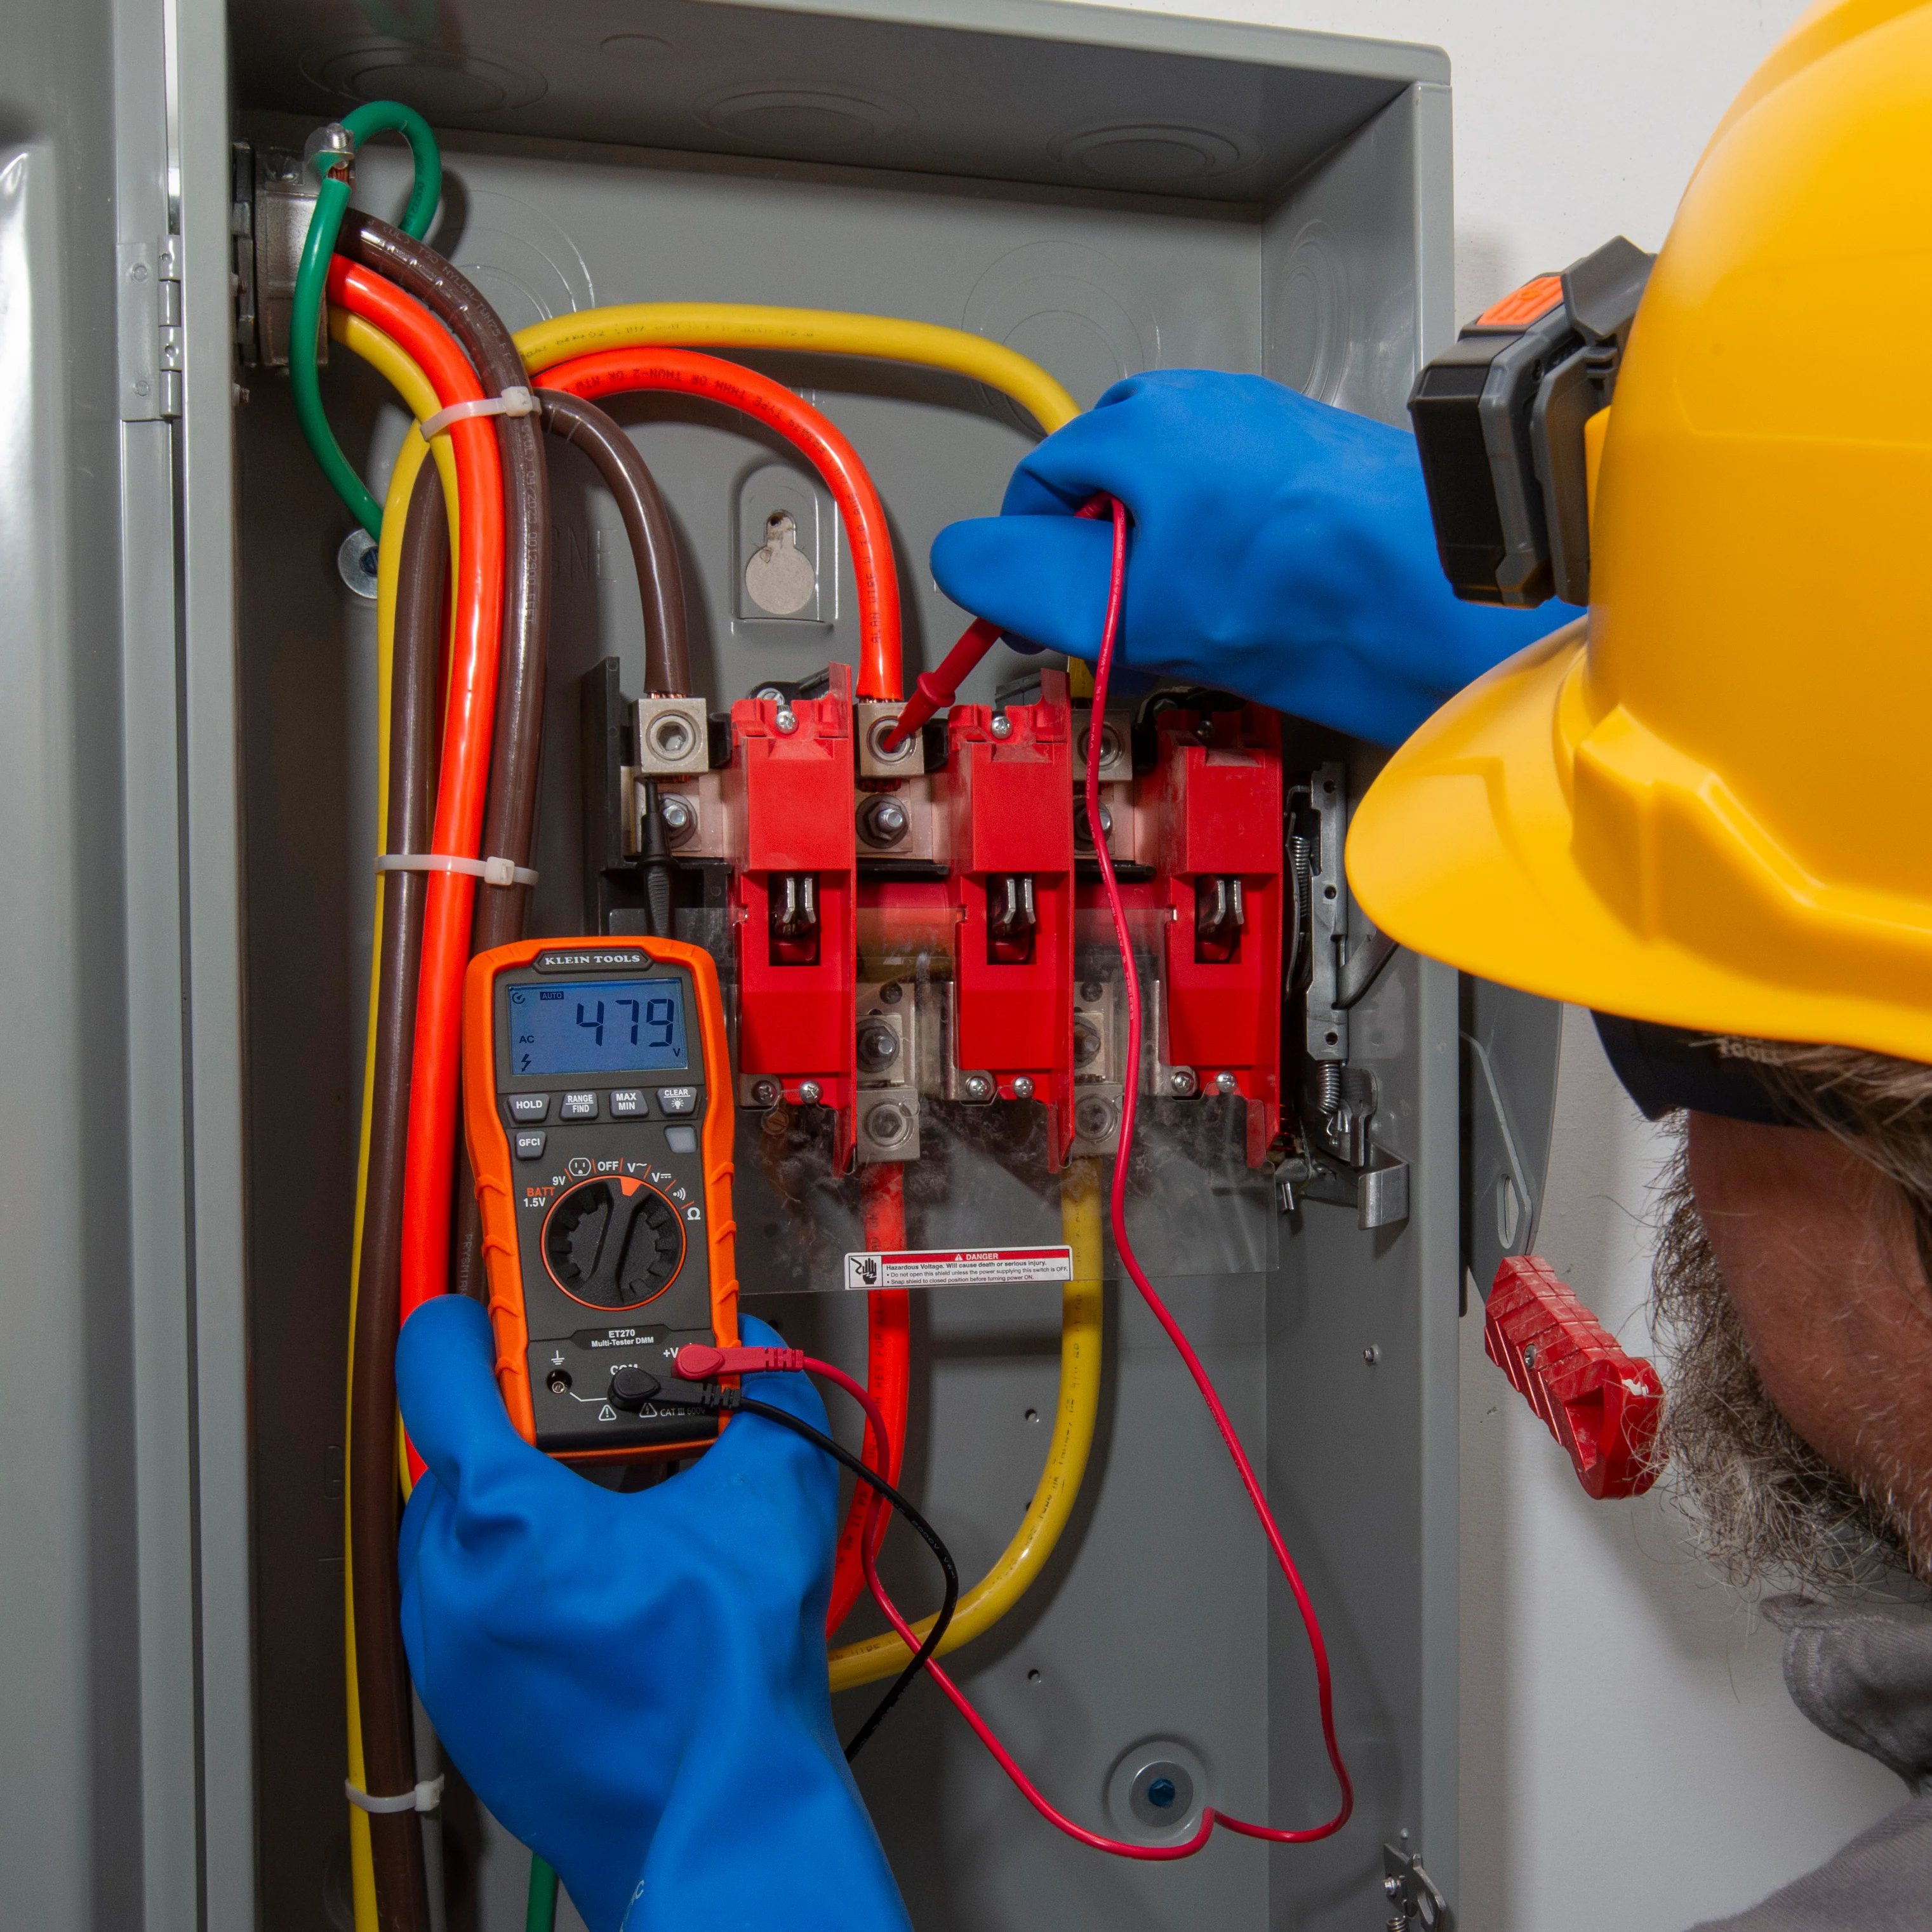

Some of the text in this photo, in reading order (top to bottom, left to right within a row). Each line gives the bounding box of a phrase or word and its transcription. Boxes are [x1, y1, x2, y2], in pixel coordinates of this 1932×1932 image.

[608, 370, 624, 381] OR
[632, 368, 682, 382] THWN-2
[575, 375, 601, 392] MTW
[691, 375, 708, 387] OR
[752, 396, 782, 419] TYPE
[1100, 648, 1108, 675] AWM
[545, 954, 641, 966] KLEIN TOOLS
[576, 998, 674, 1047] 479
[519, 1035, 535, 1044] AC
[672, 1048, 681, 1057] V
[567, 1094, 593, 1103] RANGE
[616, 1093, 637, 1102] MAX
[516, 1100, 543, 1109] HOLD
[572, 1104, 590, 1113] FIND
[618, 1102, 636, 1110] MIN
[518, 1138, 540, 1147] GFCI
[597, 1161, 619, 1172] OFF
[552, 1176, 566, 1186] 9V
[526, 1186, 556, 1197] BATT
[523, 1197, 546, 1208] 1.5V
[608, 1329, 636, 1338] ET270
[591, 1336, 654, 1348] Multi-Tester DMM
[875, 1333, 884, 1356] FOR
[875, 1366, 884, 1389] RES
[660, 1409, 676, 1417] CAT
[687, 1407, 705, 1415] 600V
